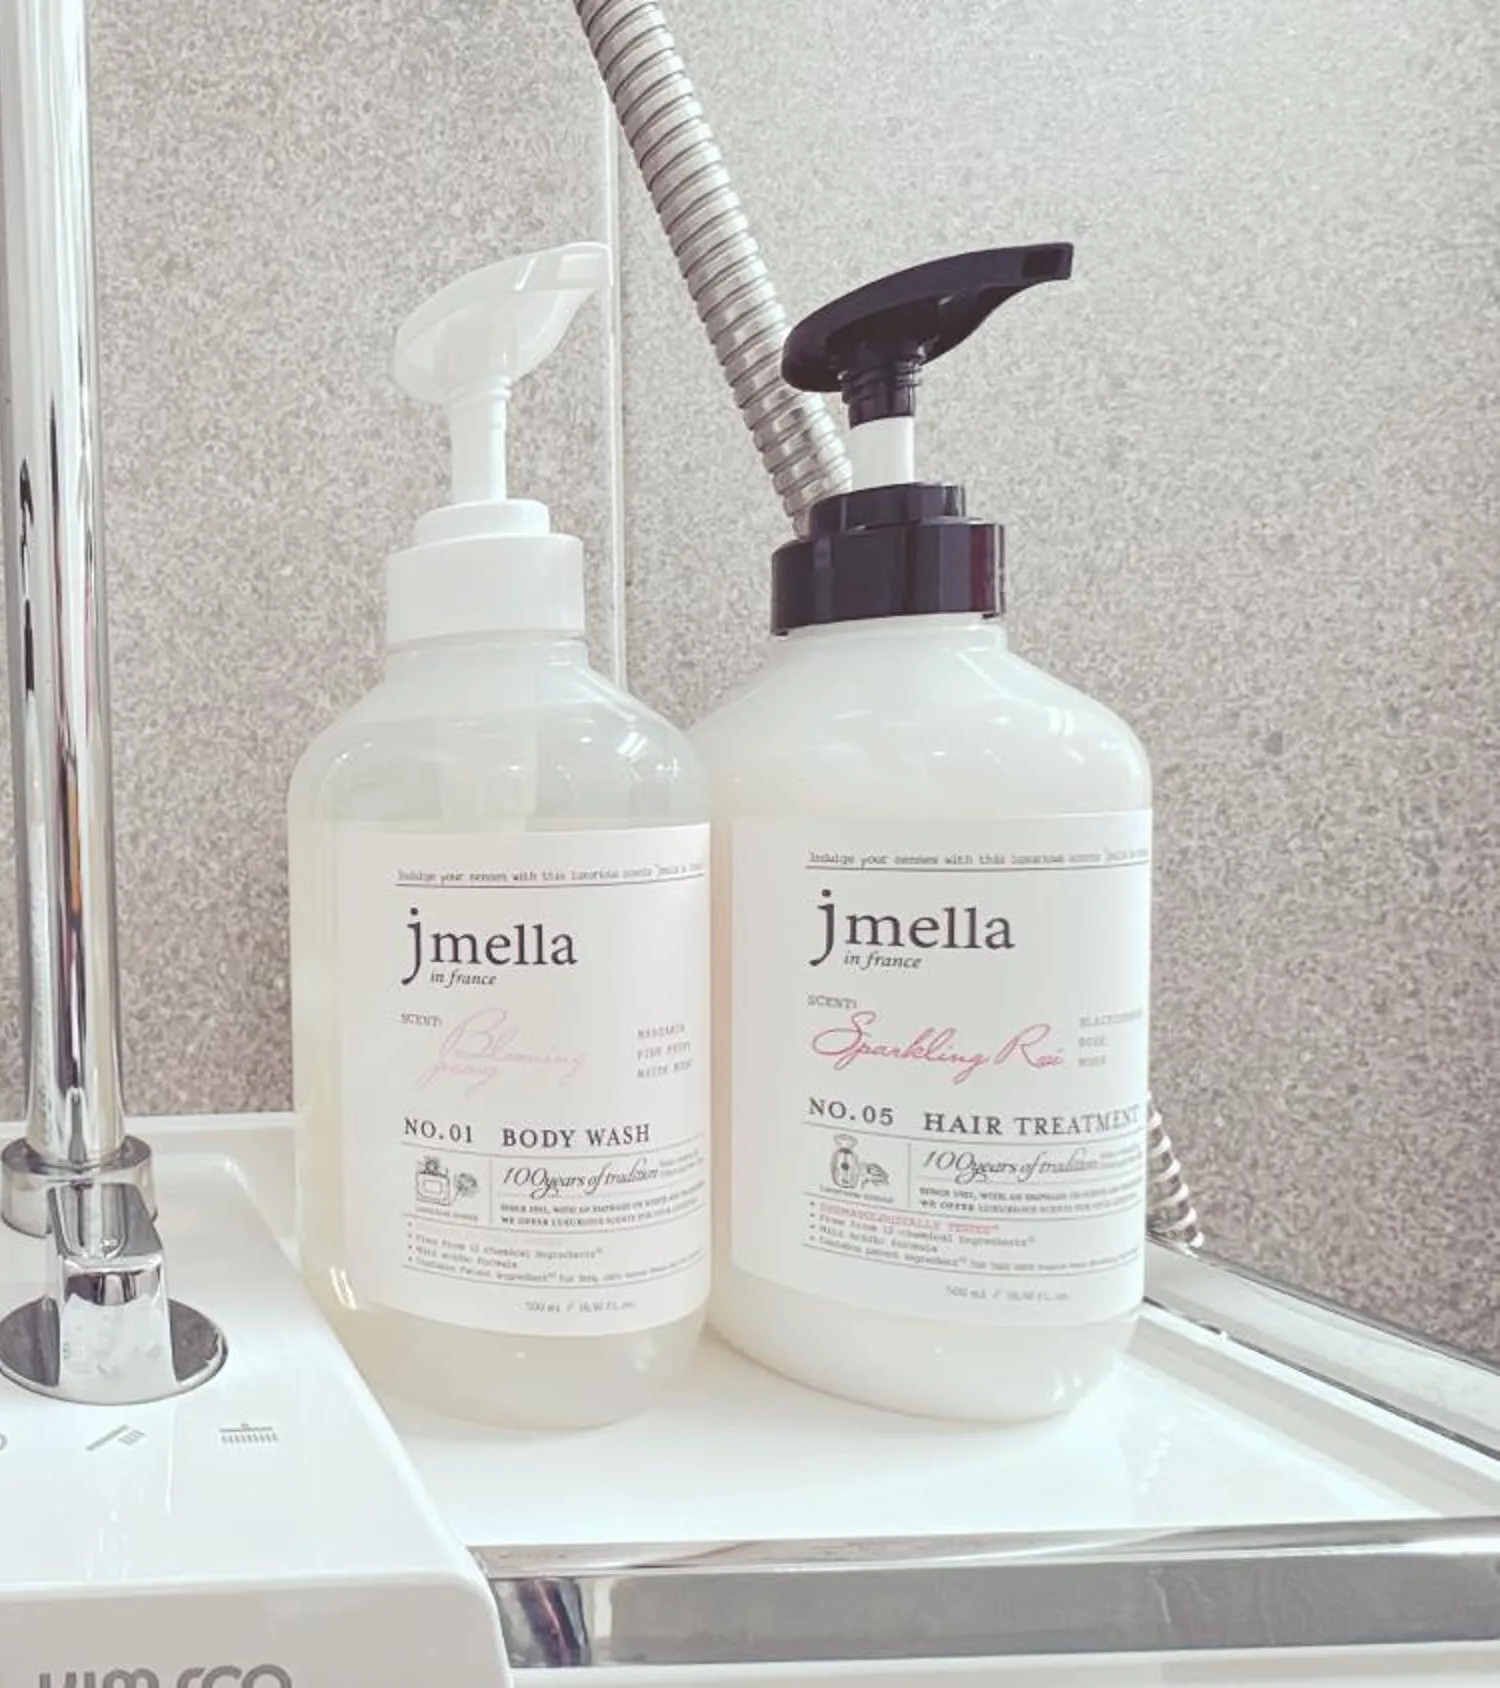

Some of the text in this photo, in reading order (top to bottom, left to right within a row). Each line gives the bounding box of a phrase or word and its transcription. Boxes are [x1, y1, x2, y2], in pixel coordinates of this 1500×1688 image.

[400, 906, 579, 987] jmella
[808, 888, 1017, 968] jmella
[429, 969, 498, 989] in france
[842, 949, 924, 971] in france
[810, 1009, 990, 1086] Sparkling
[403, 1116, 651, 1149] NO.01 BODY WASH
[807, 1096, 1141, 1137] NO.05 HAIR TREATMENT
